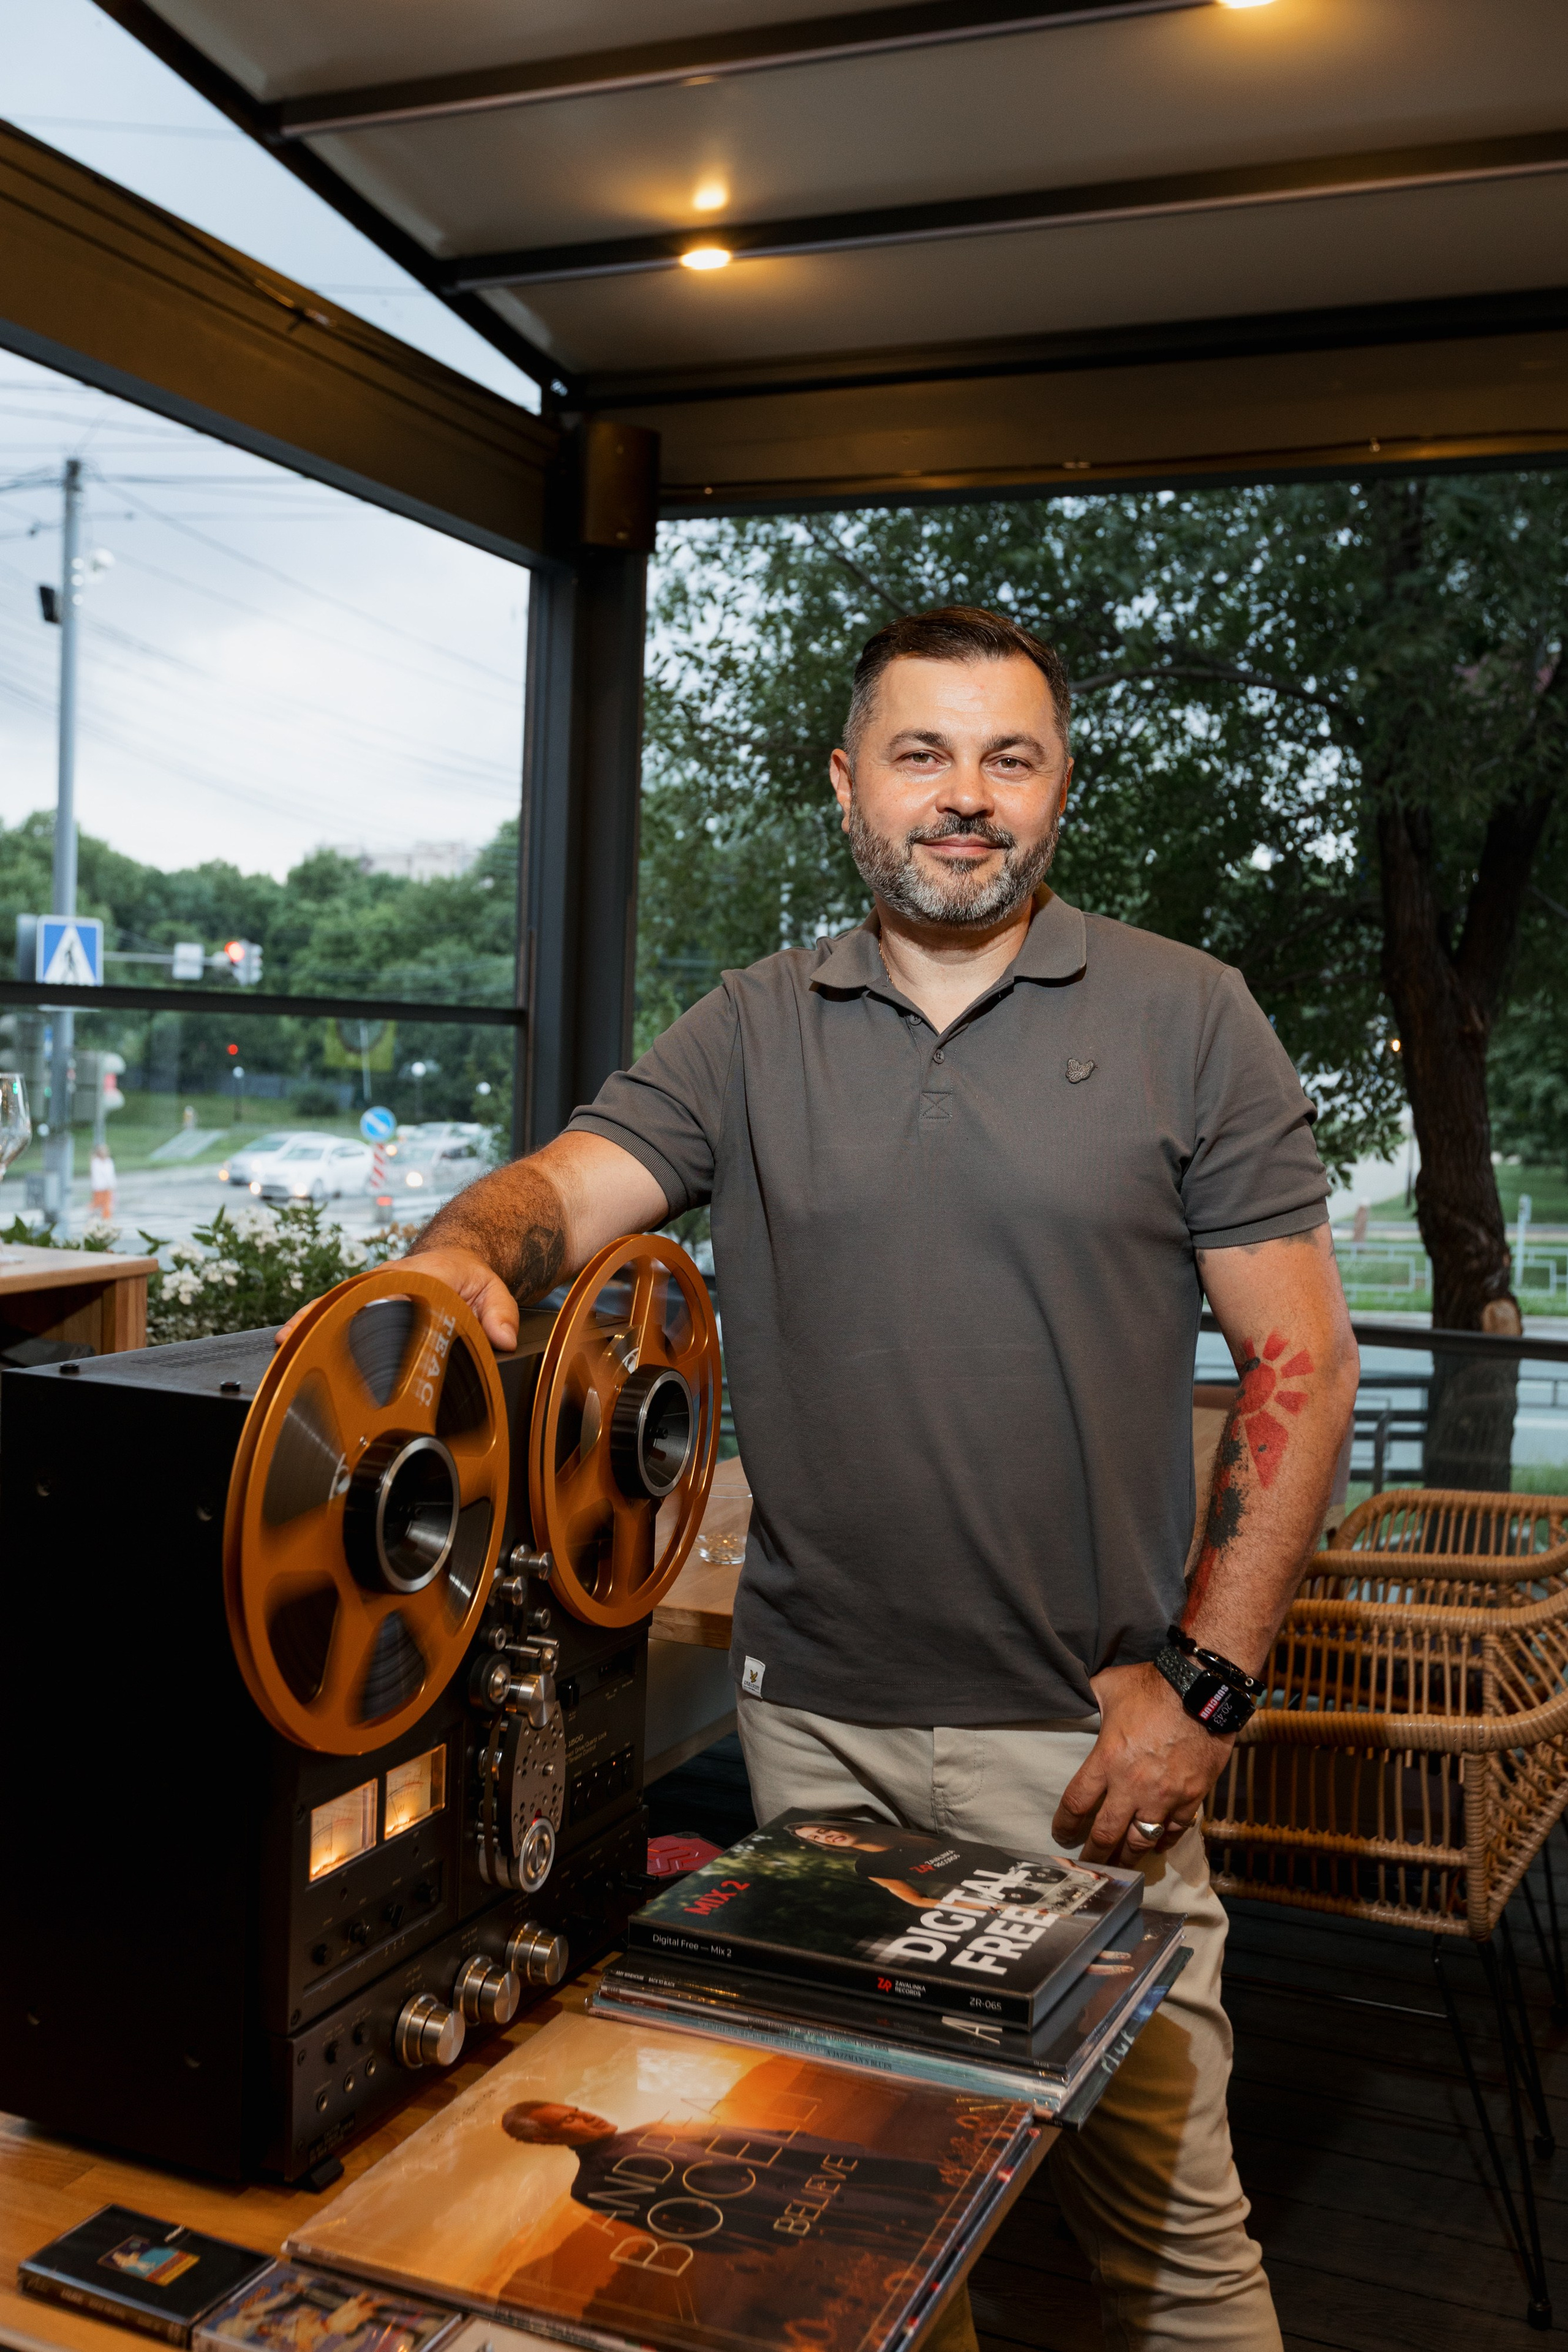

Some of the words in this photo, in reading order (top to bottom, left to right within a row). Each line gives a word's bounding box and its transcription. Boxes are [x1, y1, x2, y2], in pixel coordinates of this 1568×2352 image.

[421, 1315, 455, 1407] TEAC
[1200, 1684, 1229, 1719] SUBCLUB
[1213, 1702, 1233, 1725] 20:43
[684, 1888, 737, 1915] MIX
[720, 1880, 750, 1891] 2
[884, 1862, 1036, 1962] DIGITAL
[652, 1933, 679, 1948] Digital
[681, 1940, 699, 1951] Free
[710, 1945, 725, 1957] Mix
[726, 1948, 732, 1958] 2
[951, 1905, 1061, 1975] FREE
[894, 1980, 926, 1992] ZAVALINKA
[894, 1987, 921, 1998] RECORDS
[969, 1996, 1003, 2011] ZR-065
[744, 2031, 761, 2040] FROM
[764, 2035, 775, 2044] THE
[808, 2046, 824, 2054] FILM
[832, 2051, 869, 2065] JAZZMAN'S
[871, 2059, 892, 2070] BLUES
[610, 2090, 823, 2277] BOCELLI
[773, 2154, 858, 2237] BELIEVE
